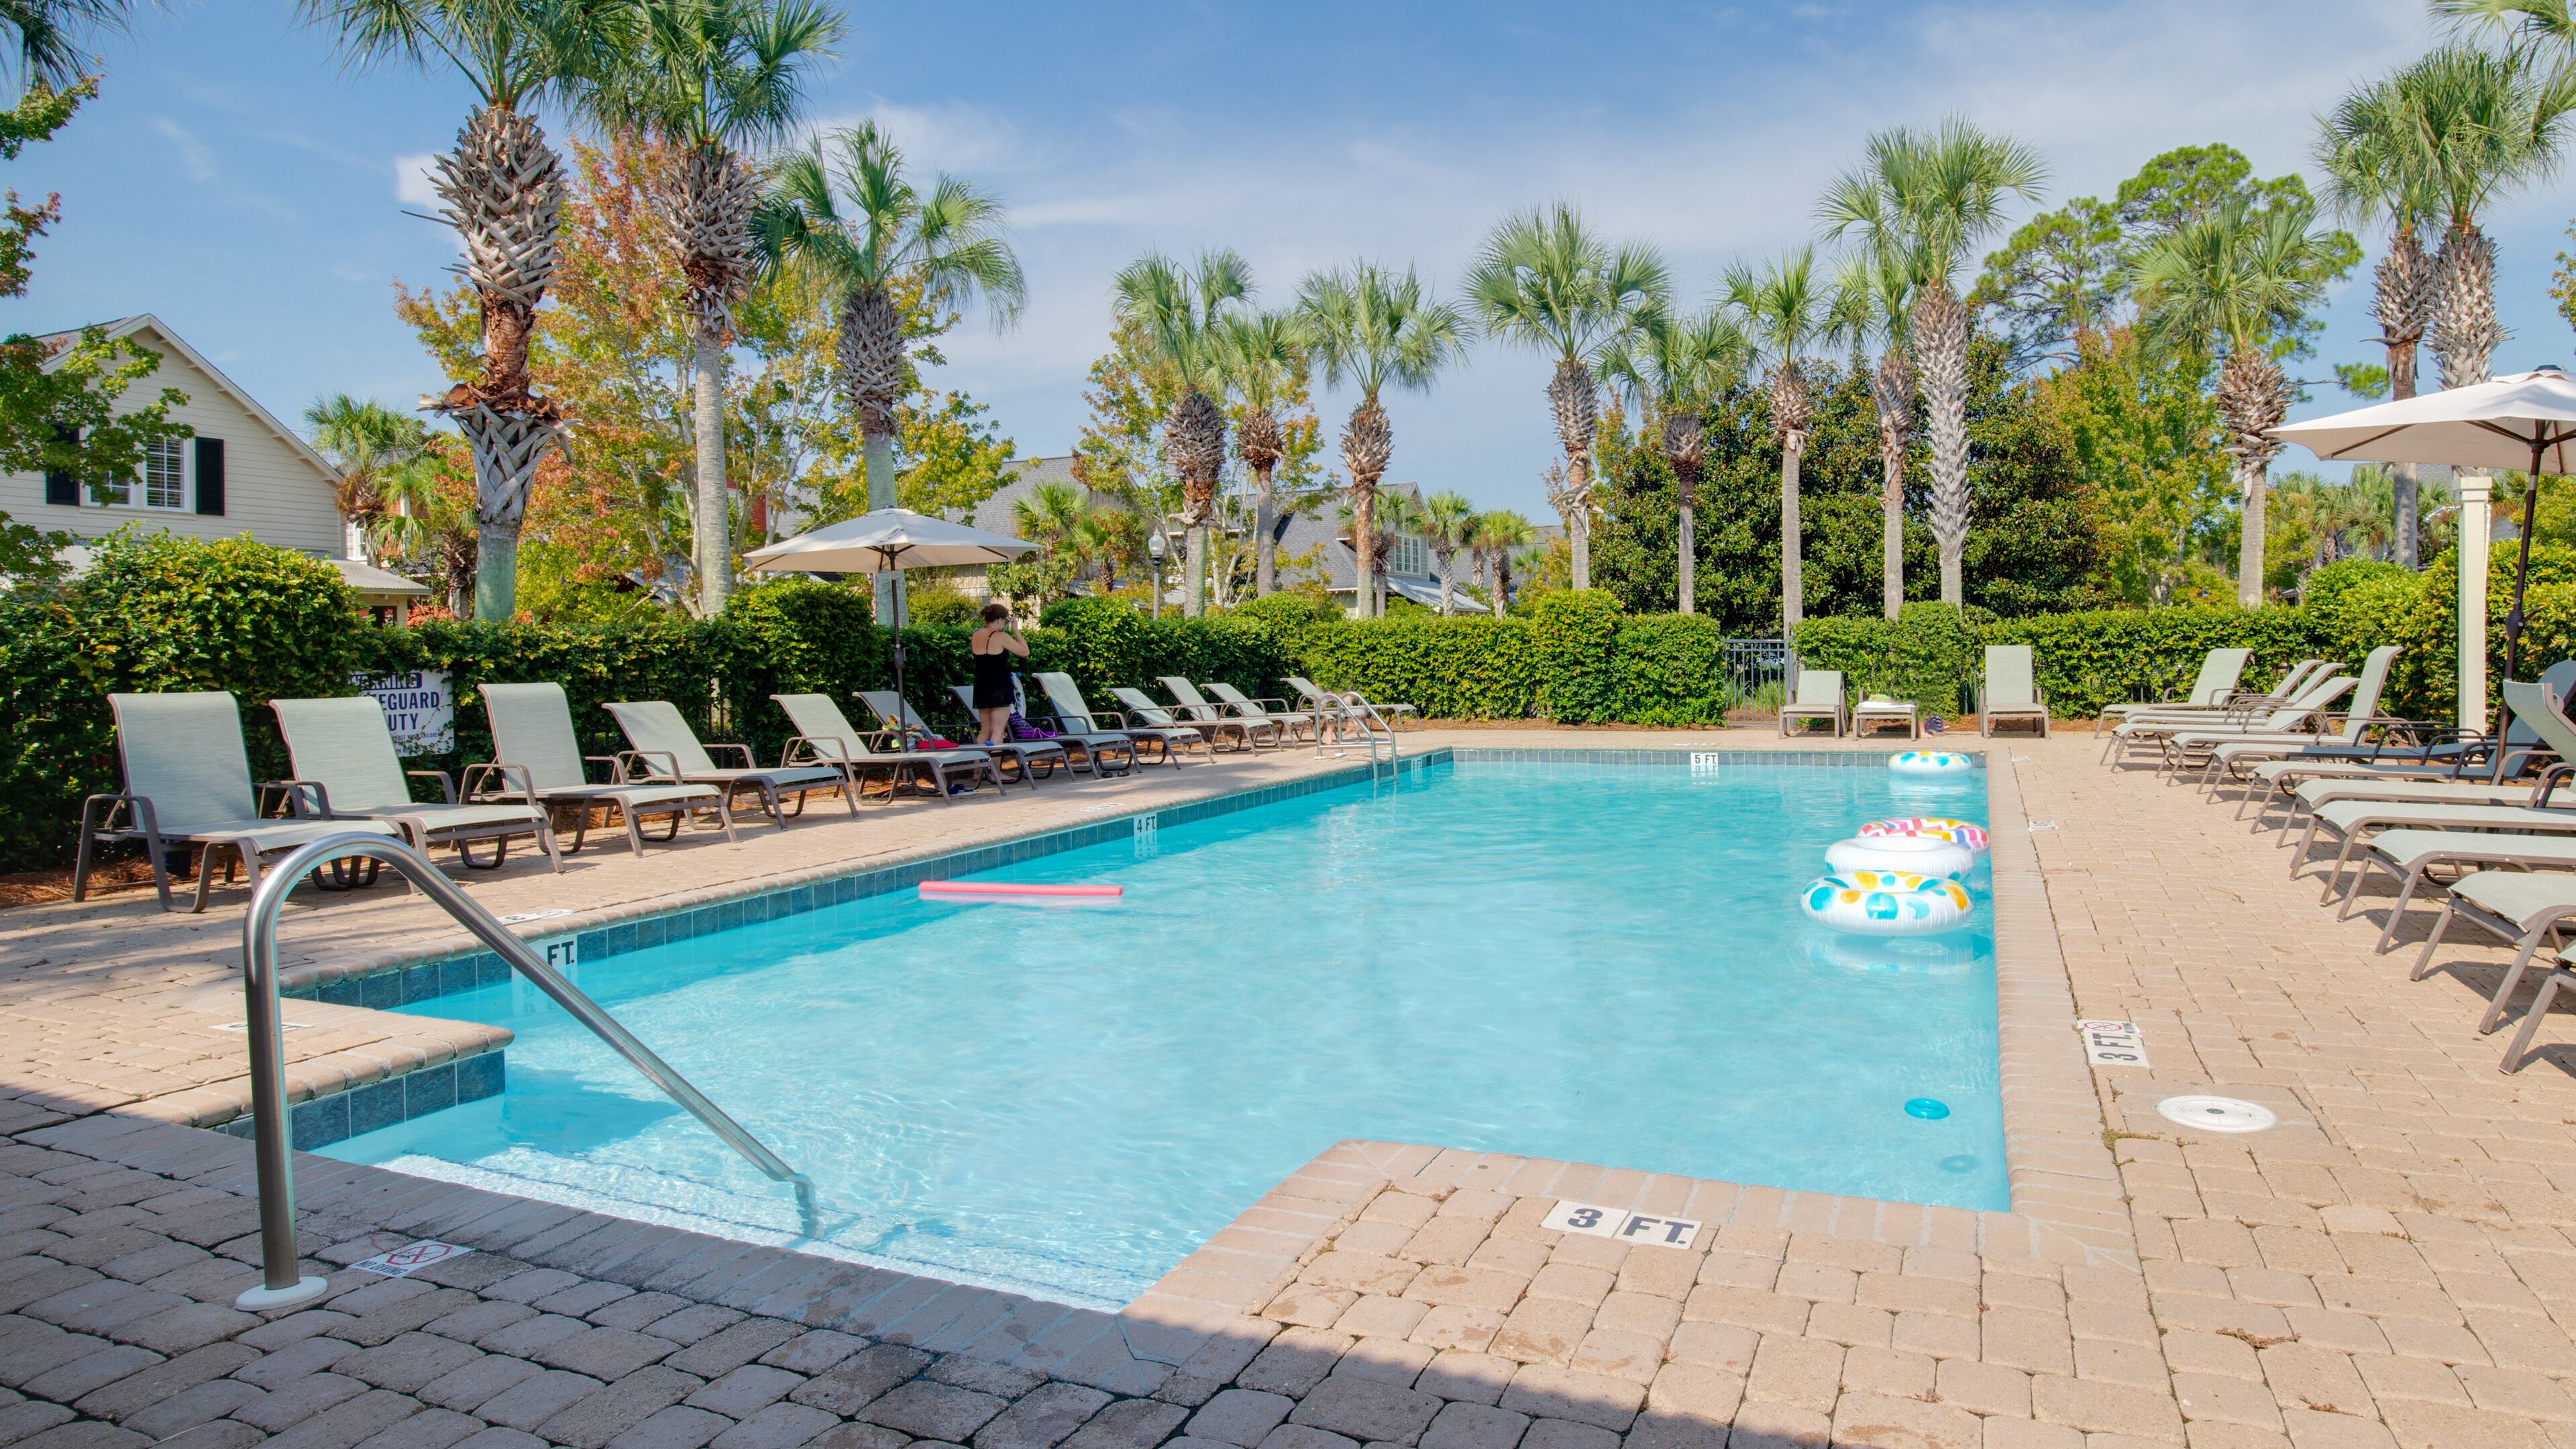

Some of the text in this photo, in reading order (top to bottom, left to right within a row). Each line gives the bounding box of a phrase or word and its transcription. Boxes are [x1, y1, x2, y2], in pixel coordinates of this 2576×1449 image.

[373, 692, 440, 711] EGUARD
[388, 712, 419, 731] UTY
[1695, 754, 1717, 764] 5 FT.
[1136, 815, 1156, 833] 4 FT.
[547, 940, 575, 967] FT.
[2092, 1033, 2139, 1061] 3 FT.
[1567, 1208, 1695, 1244] 3 FT.
